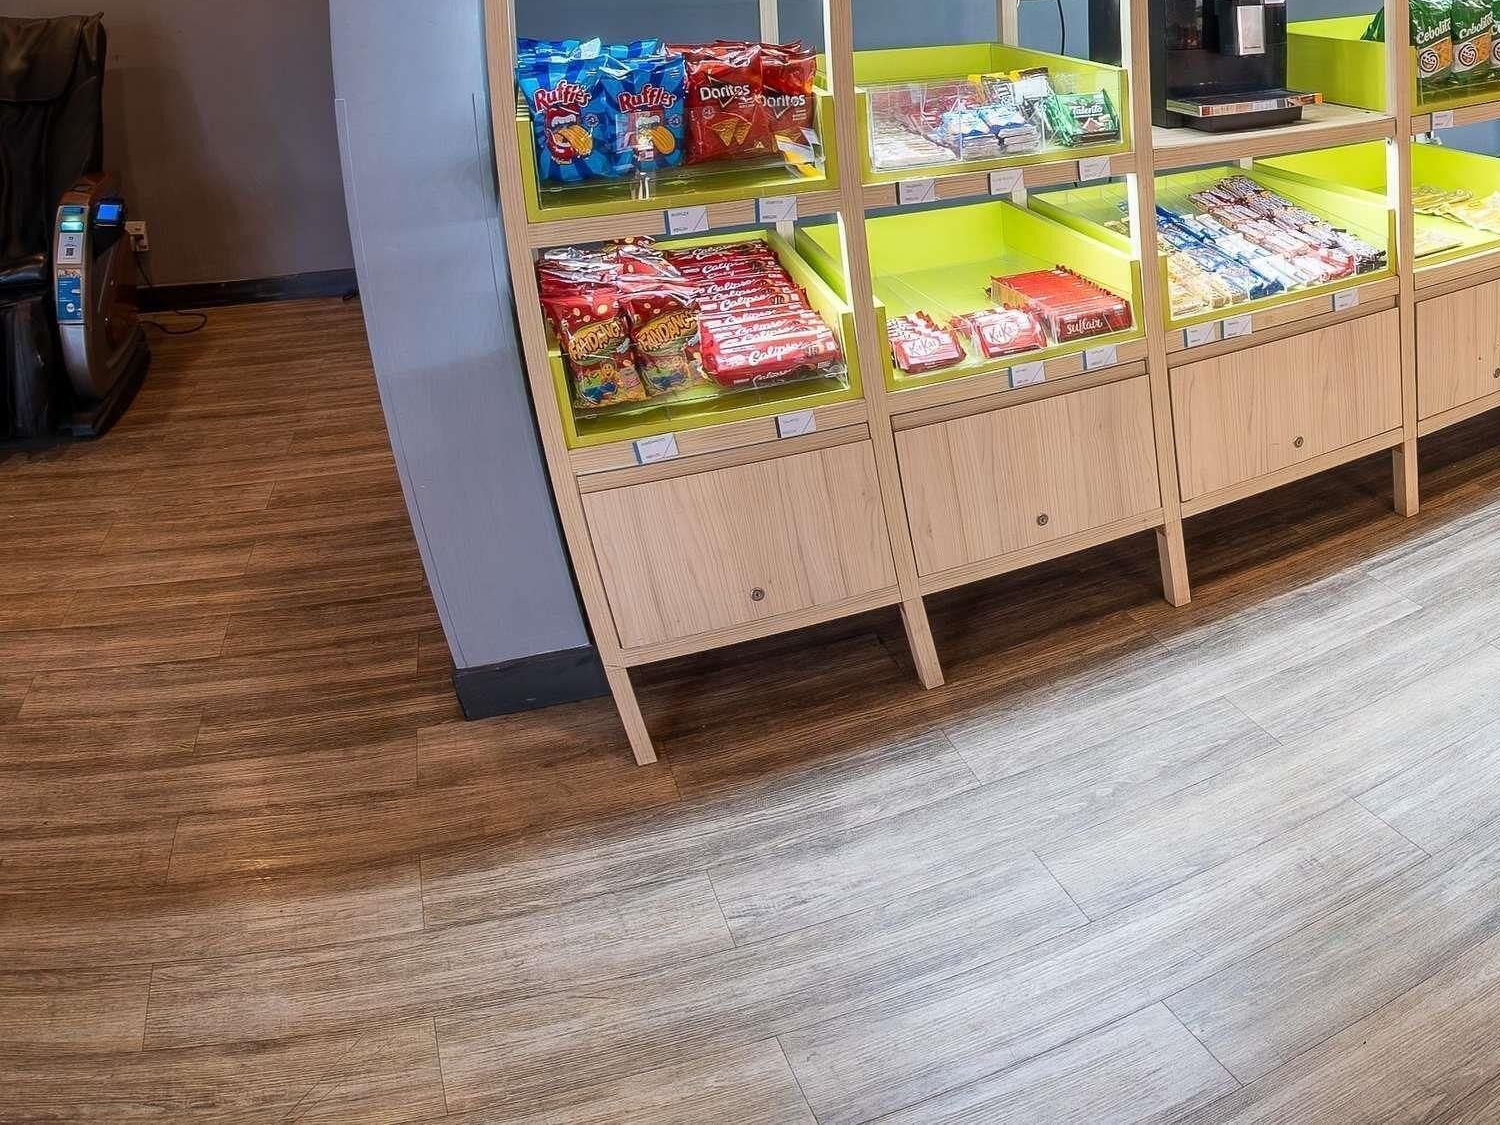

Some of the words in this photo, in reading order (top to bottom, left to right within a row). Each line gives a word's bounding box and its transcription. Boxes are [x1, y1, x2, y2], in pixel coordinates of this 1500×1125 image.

[534, 79, 592, 114] Ruffles
[617, 83, 677, 115] Ruffles
[699, 83, 750, 102] Doritos
[1070, 104, 1104, 118] Talento
[720, 293, 771, 311] Calipso
[1066, 318, 1103, 335] suflair
[749, 342, 803, 366] Calipso
